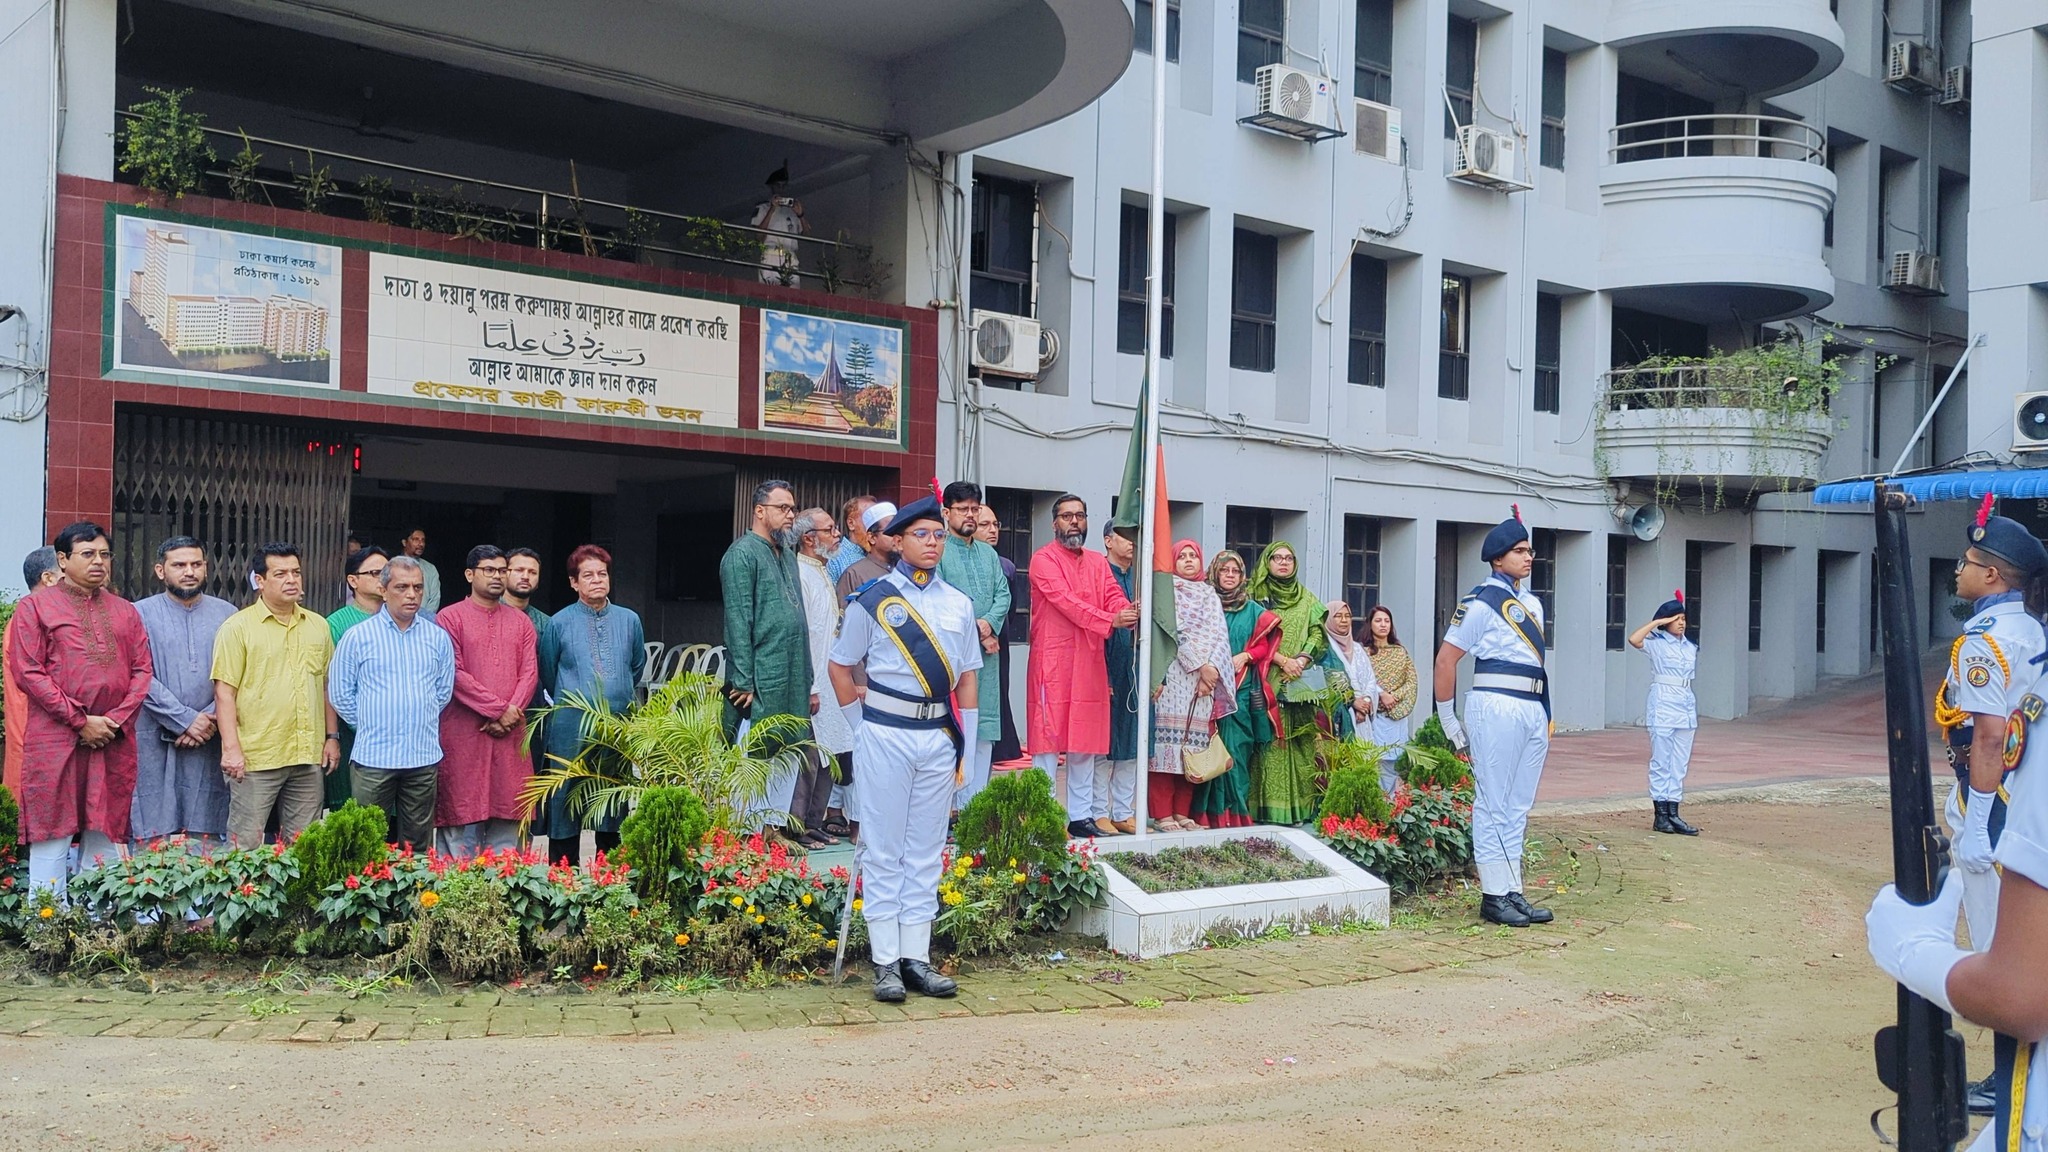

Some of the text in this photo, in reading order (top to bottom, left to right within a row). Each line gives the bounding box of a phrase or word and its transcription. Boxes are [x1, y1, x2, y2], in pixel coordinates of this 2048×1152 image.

[239, 250, 317, 269] ঢাকা কমার্স কলেজ
[290, 274, 320, 286] ১৯৮৯
[384, 275, 729, 341] দাতা ও দয়ালু পরম করুণাময় আল্লাহর নামে প্রবেশ করছি
[468, 358, 658, 396] আল্লাহ আমাকে জ্ঞান দান করুন
[413, 381, 704, 423] প্রফেসর কাজী ফারুকী ভবন
